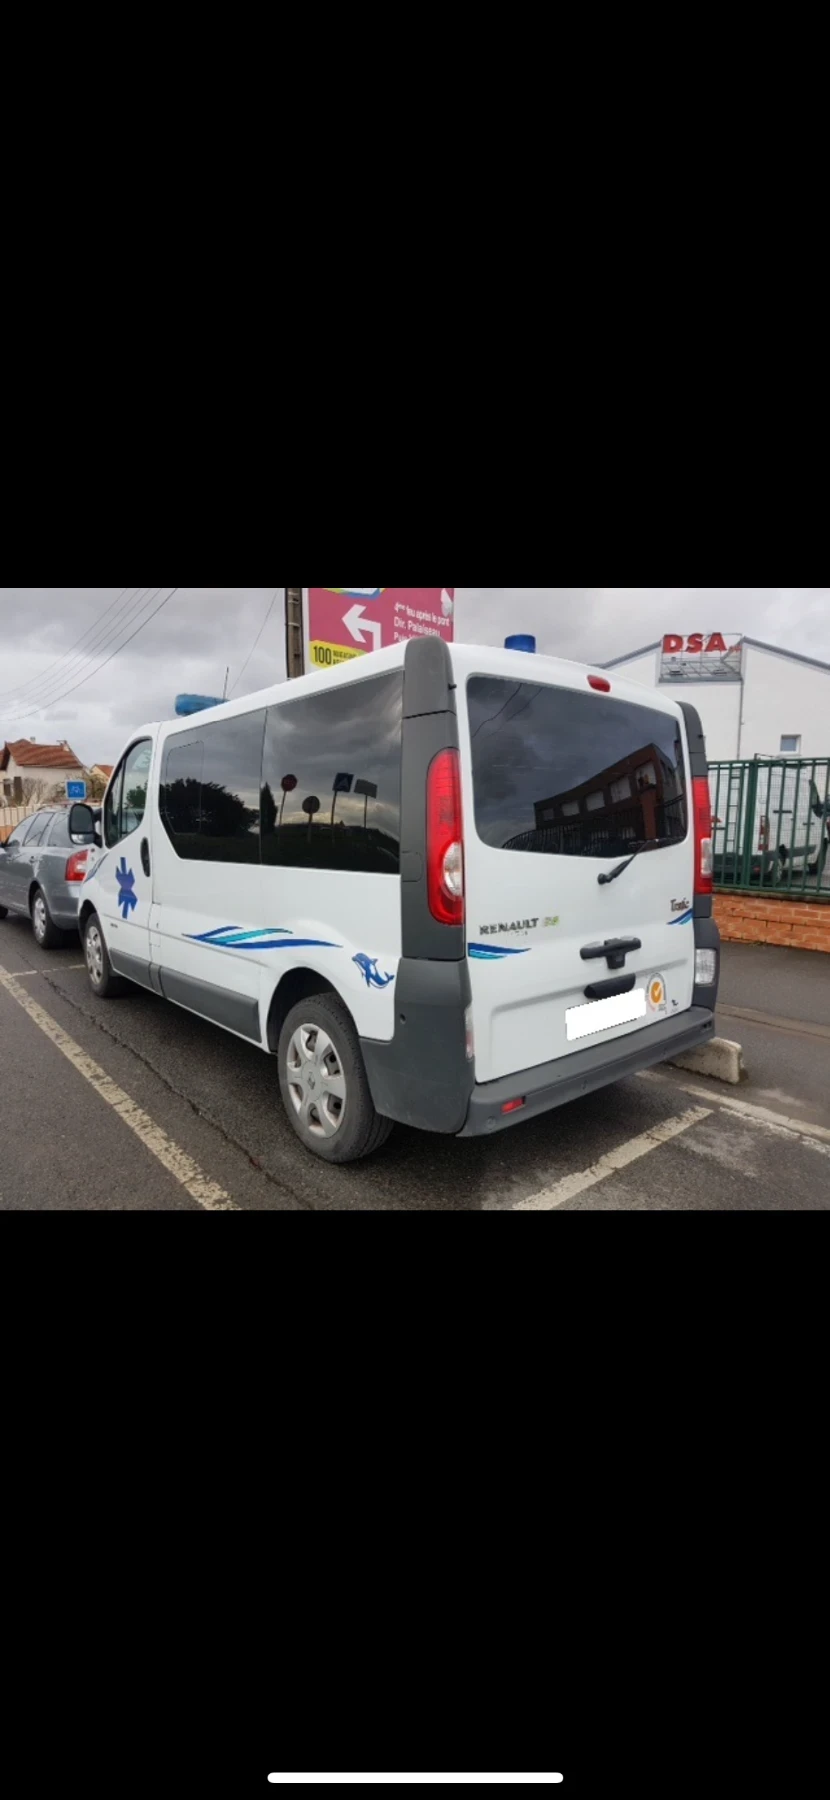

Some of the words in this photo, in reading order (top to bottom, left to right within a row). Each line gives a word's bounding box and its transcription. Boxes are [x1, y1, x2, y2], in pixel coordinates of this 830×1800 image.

[393, 616, 407, 629] Dir.
[407, 620, 441, 637] Palaiseau
[437, 616, 450, 627] pont
[662, 632, 727, 653] DSA
[313, 645, 332, 665] 100
[479, 917, 540, 936] RENAULT
